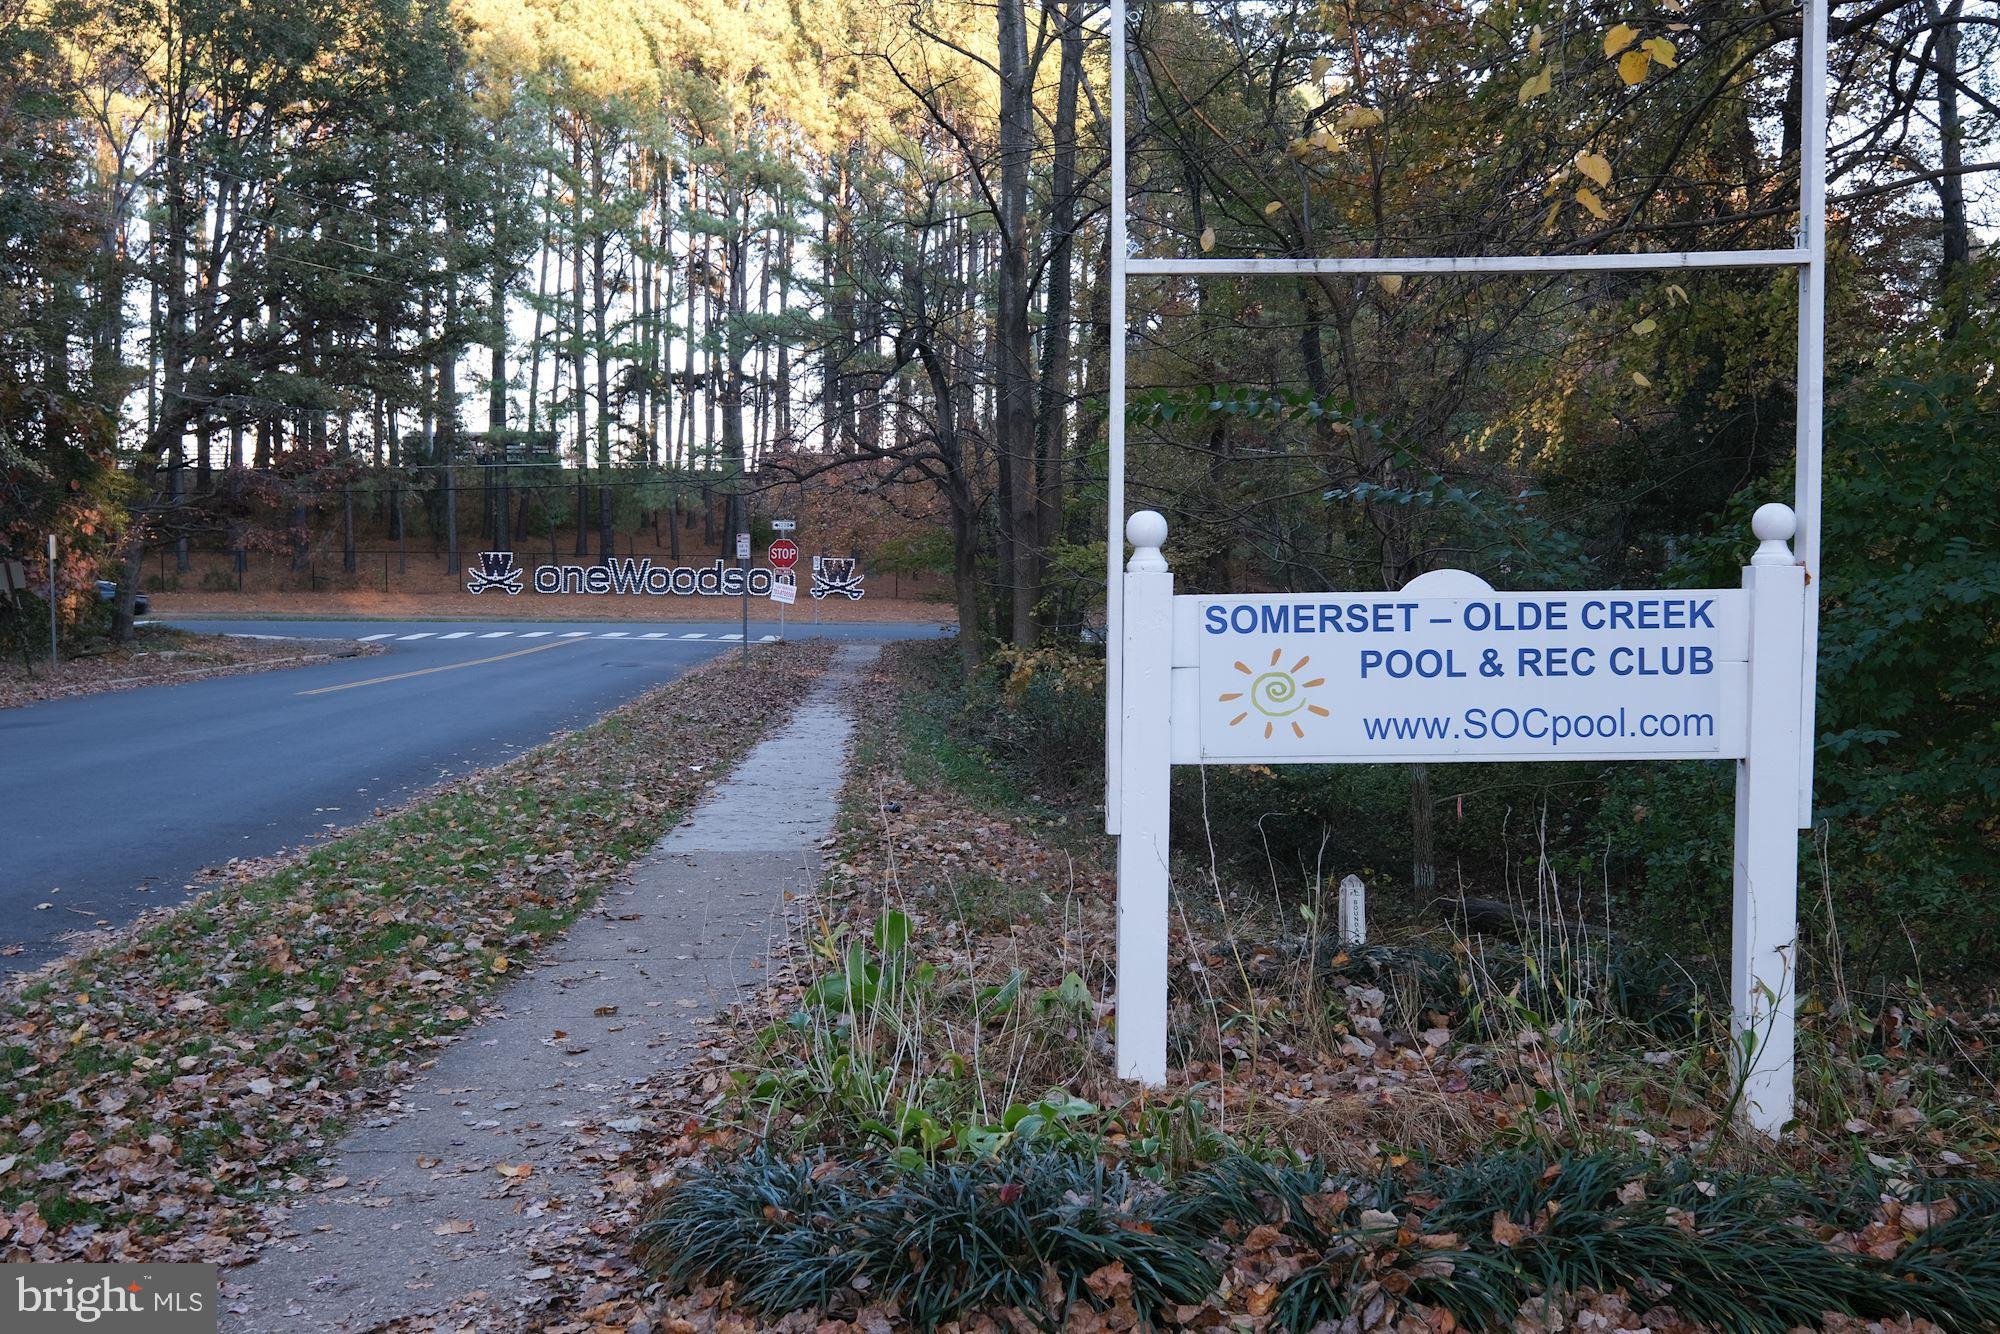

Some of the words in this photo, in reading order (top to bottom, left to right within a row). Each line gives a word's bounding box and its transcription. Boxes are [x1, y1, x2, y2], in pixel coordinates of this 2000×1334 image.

[771, 548, 796, 560] STOP
[1205, 604, 1418, 634] SOMERSET
[1463, 601, 1568, 632] OLDE
[1581, 600, 1714, 630] CREEK
[1360, 649, 1467, 679] POOL
[1478, 648, 1505, 678] &
[1517, 646, 1596, 677] REC
[1609, 646, 1714, 676] CLUB
[1363, 706, 1714, 746] www.SOCpool.com
